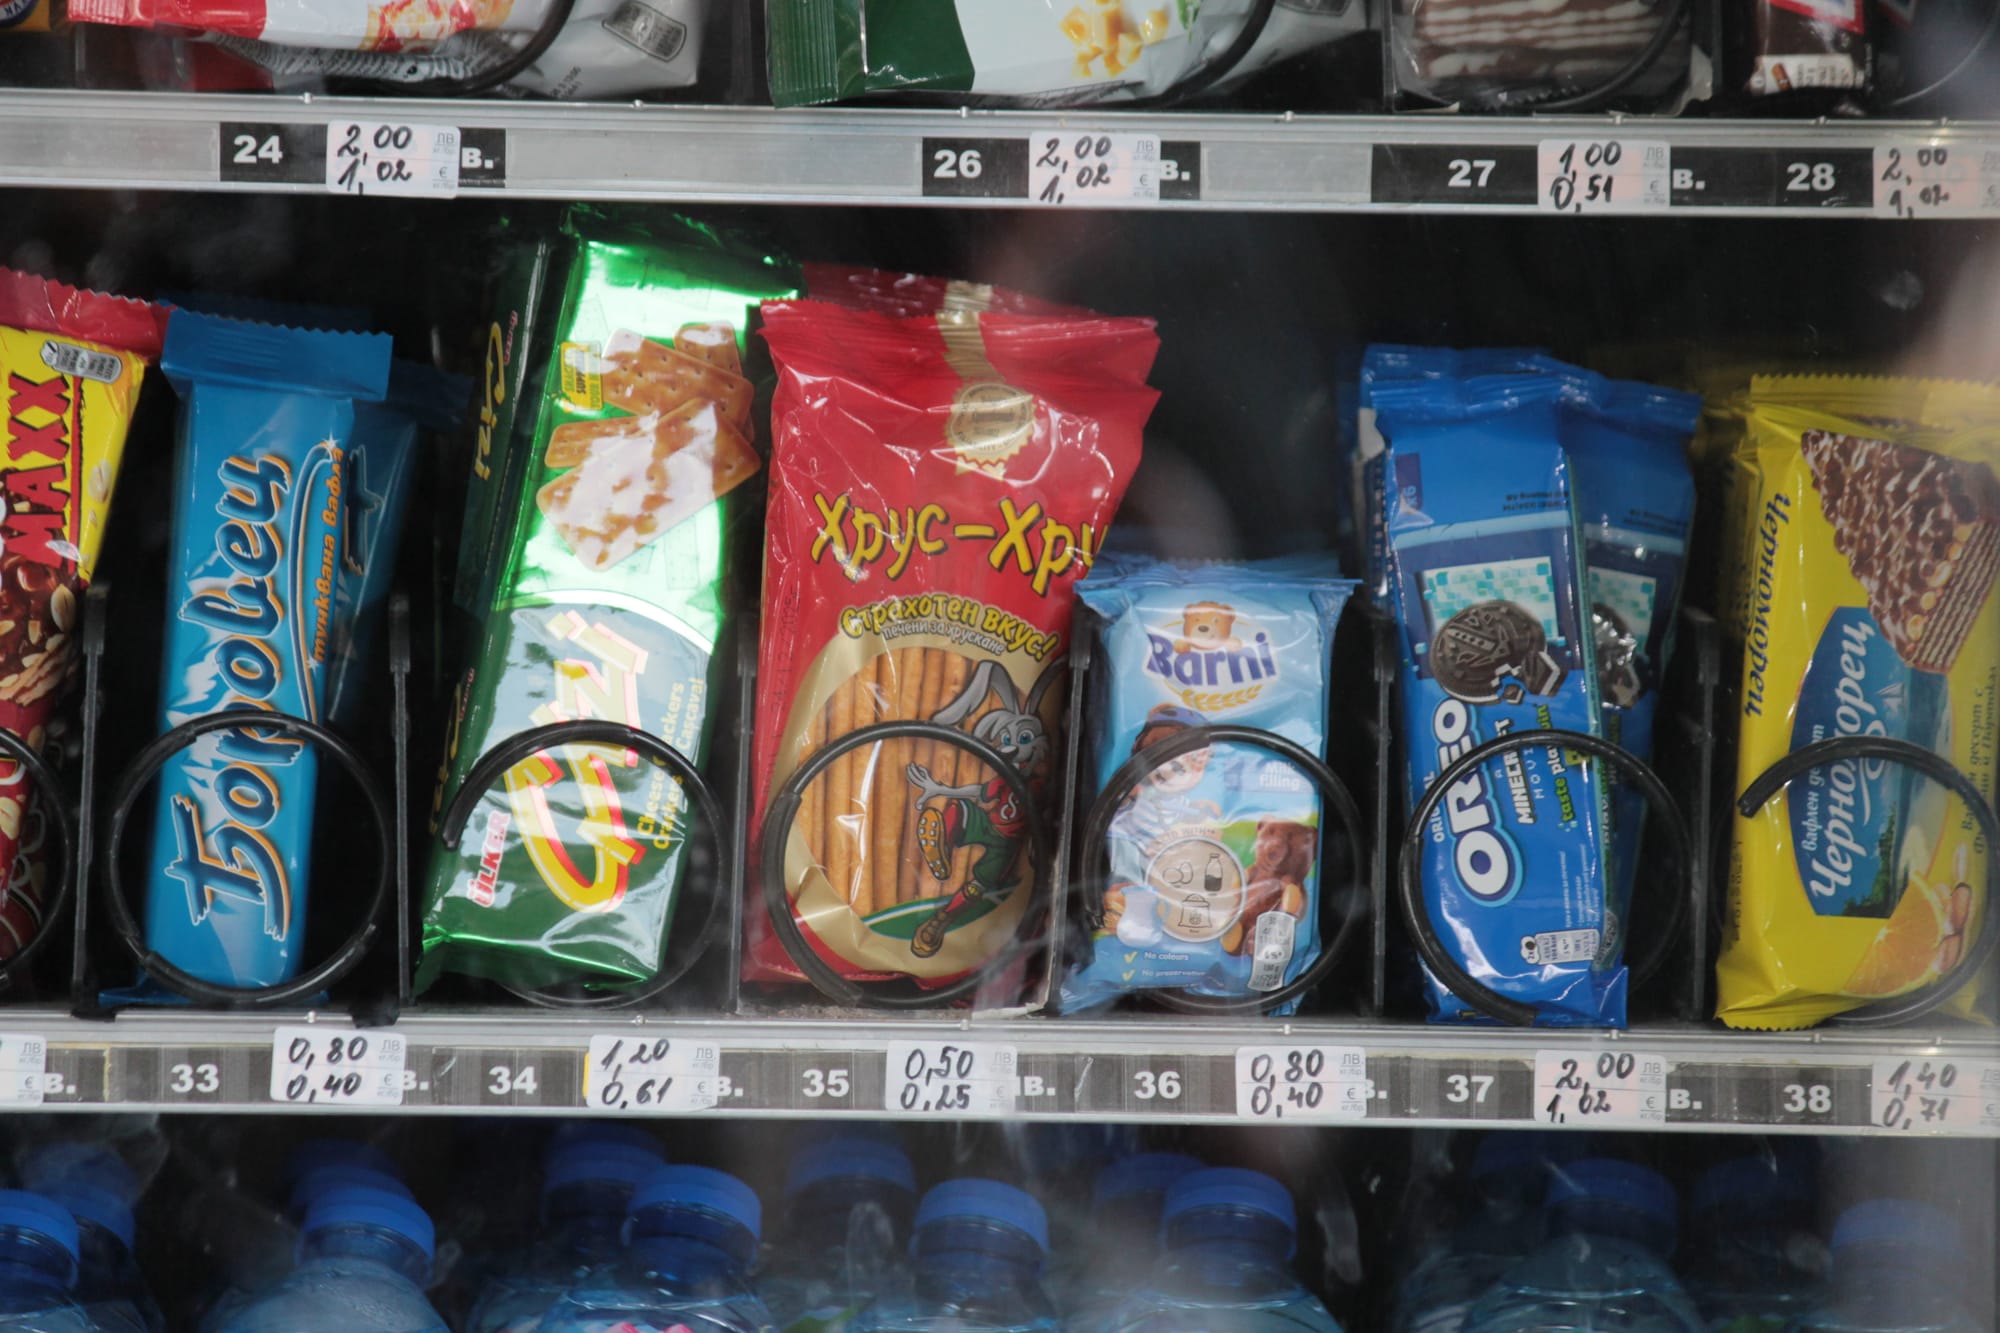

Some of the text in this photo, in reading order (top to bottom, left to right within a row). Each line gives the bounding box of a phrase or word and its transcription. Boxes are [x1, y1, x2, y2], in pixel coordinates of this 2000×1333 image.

[233, 135, 283, 163] 24
[338, 124, 412, 164] 2,00
[461, 147, 494, 168] В.
[1036, 136, 1112, 173] 2,00
[1560, 141, 1621, 184] 1,00
[338, 159, 412, 195] 1,02
[934, 150, 982, 178] 26
[1161, 160, 1190, 180] В.
[1448, 160, 1496, 187] 27
[1672, 169, 1705, 190] В.
[1786, 162, 1836, 191] 28
[1882, 148, 1947, 185] 2,00
[1040, 163, 1112, 204] 1,02
[1551, 174, 1613, 213] 0,51
[5, 370, 70, 570] MAXX
[841, 593, 978, 638] Страхотен
[1745, 493, 1791, 717] Черноморец
[1147, 632, 1277, 686] Barni
[165, 454, 304, 941] Боровец
[1495, 718, 1536, 825] MINECRT
[1524, 748, 1545, 799] MOVI
[1547, 746, 1566, 776] pla
[1810, 621, 1876, 897] Черноорец
[1433, 699, 1509, 896] OREO
[1555, 777, 1577, 822] taste
[467, 811, 511, 908] ÜLKER
[1158, 952, 1190, 961] colours
[289, 1037, 368, 1070] 0,80
[602, 1039, 670, 1081] 1,20
[905, 1046, 973, 1086] 0,50
[1251, 1049, 1325, 1091] 0,80
[170, 1064, 220, 1092] 33
[286, 1073, 362, 1102] 0,40
[489, 1066, 537, 1095] 34
[802, 1069, 849, 1097] 35
[1134, 1071, 1181, 1099] 36
[1446, 1075, 1494, 1103] 37
[1556, 1053, 1635, 1092] 2,00
[1888, 1060, 1957, 1100] 1,40
[602, 1077, 672, 1109] 0,61
[1251, 1082, 1323, 1118] 0,40
[1670, 1088, 1702, 1110] В.
[1784, 1084, 1831, 1113] 38
